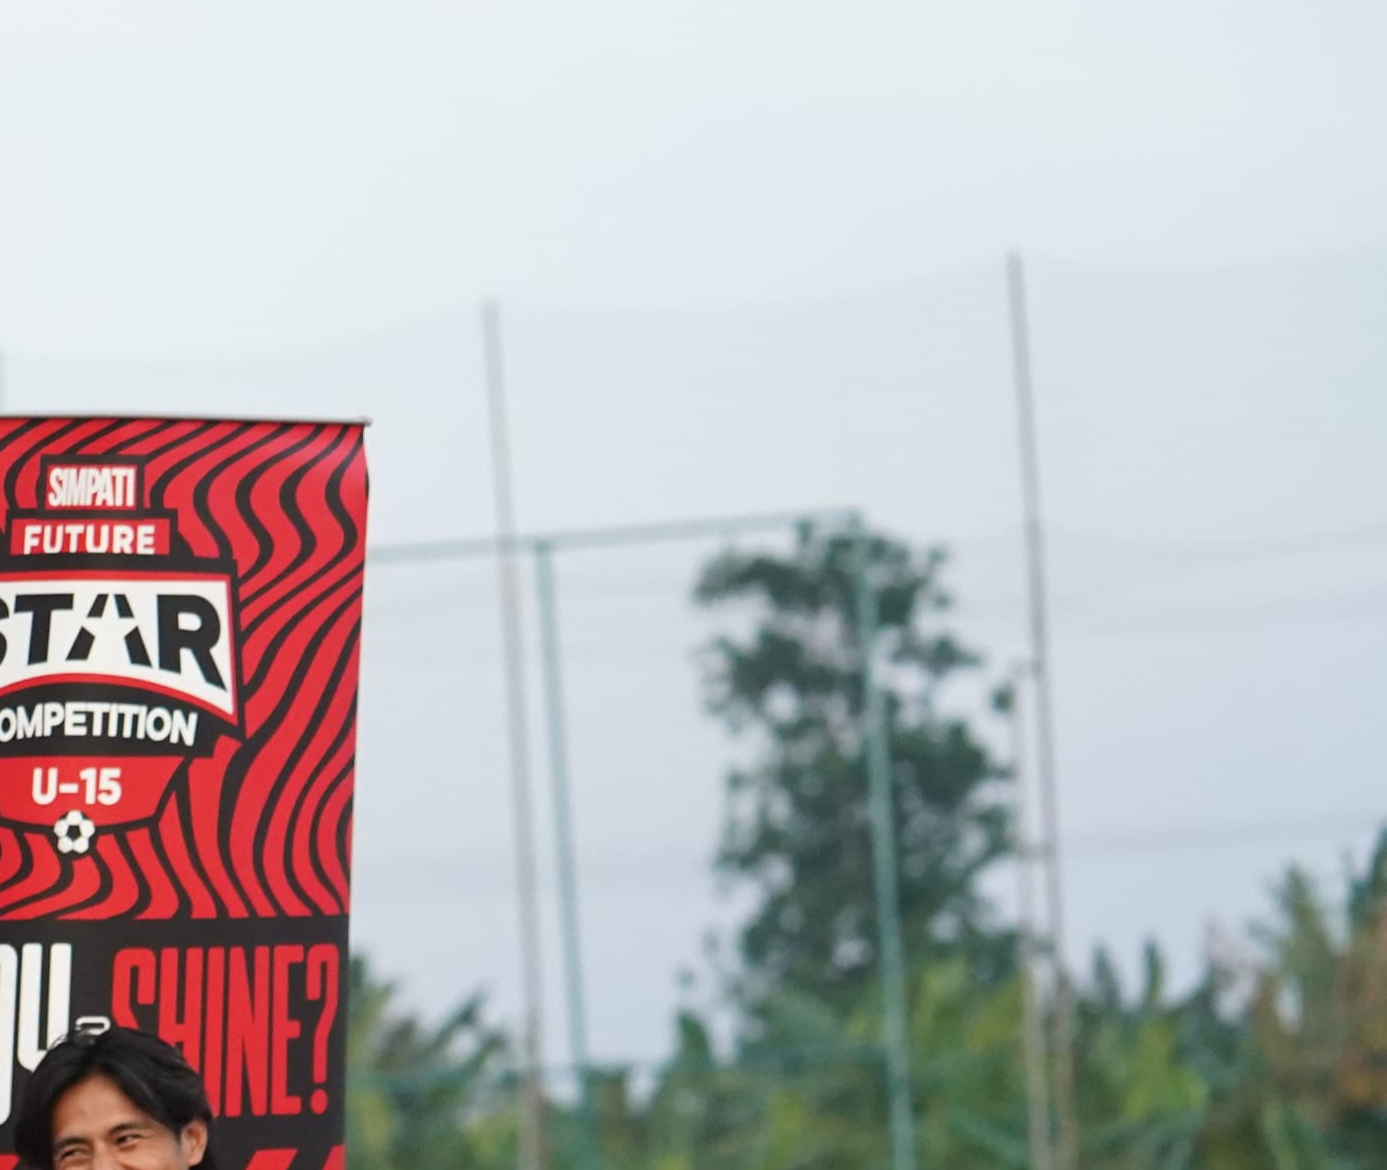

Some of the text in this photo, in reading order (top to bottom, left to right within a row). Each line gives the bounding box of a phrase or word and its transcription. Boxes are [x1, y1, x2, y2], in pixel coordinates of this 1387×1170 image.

[48, 467, 135, 507] SIMPATI
[23, 525, 155, 555] FUTURE
[32, 767, 122, 806] U-15
